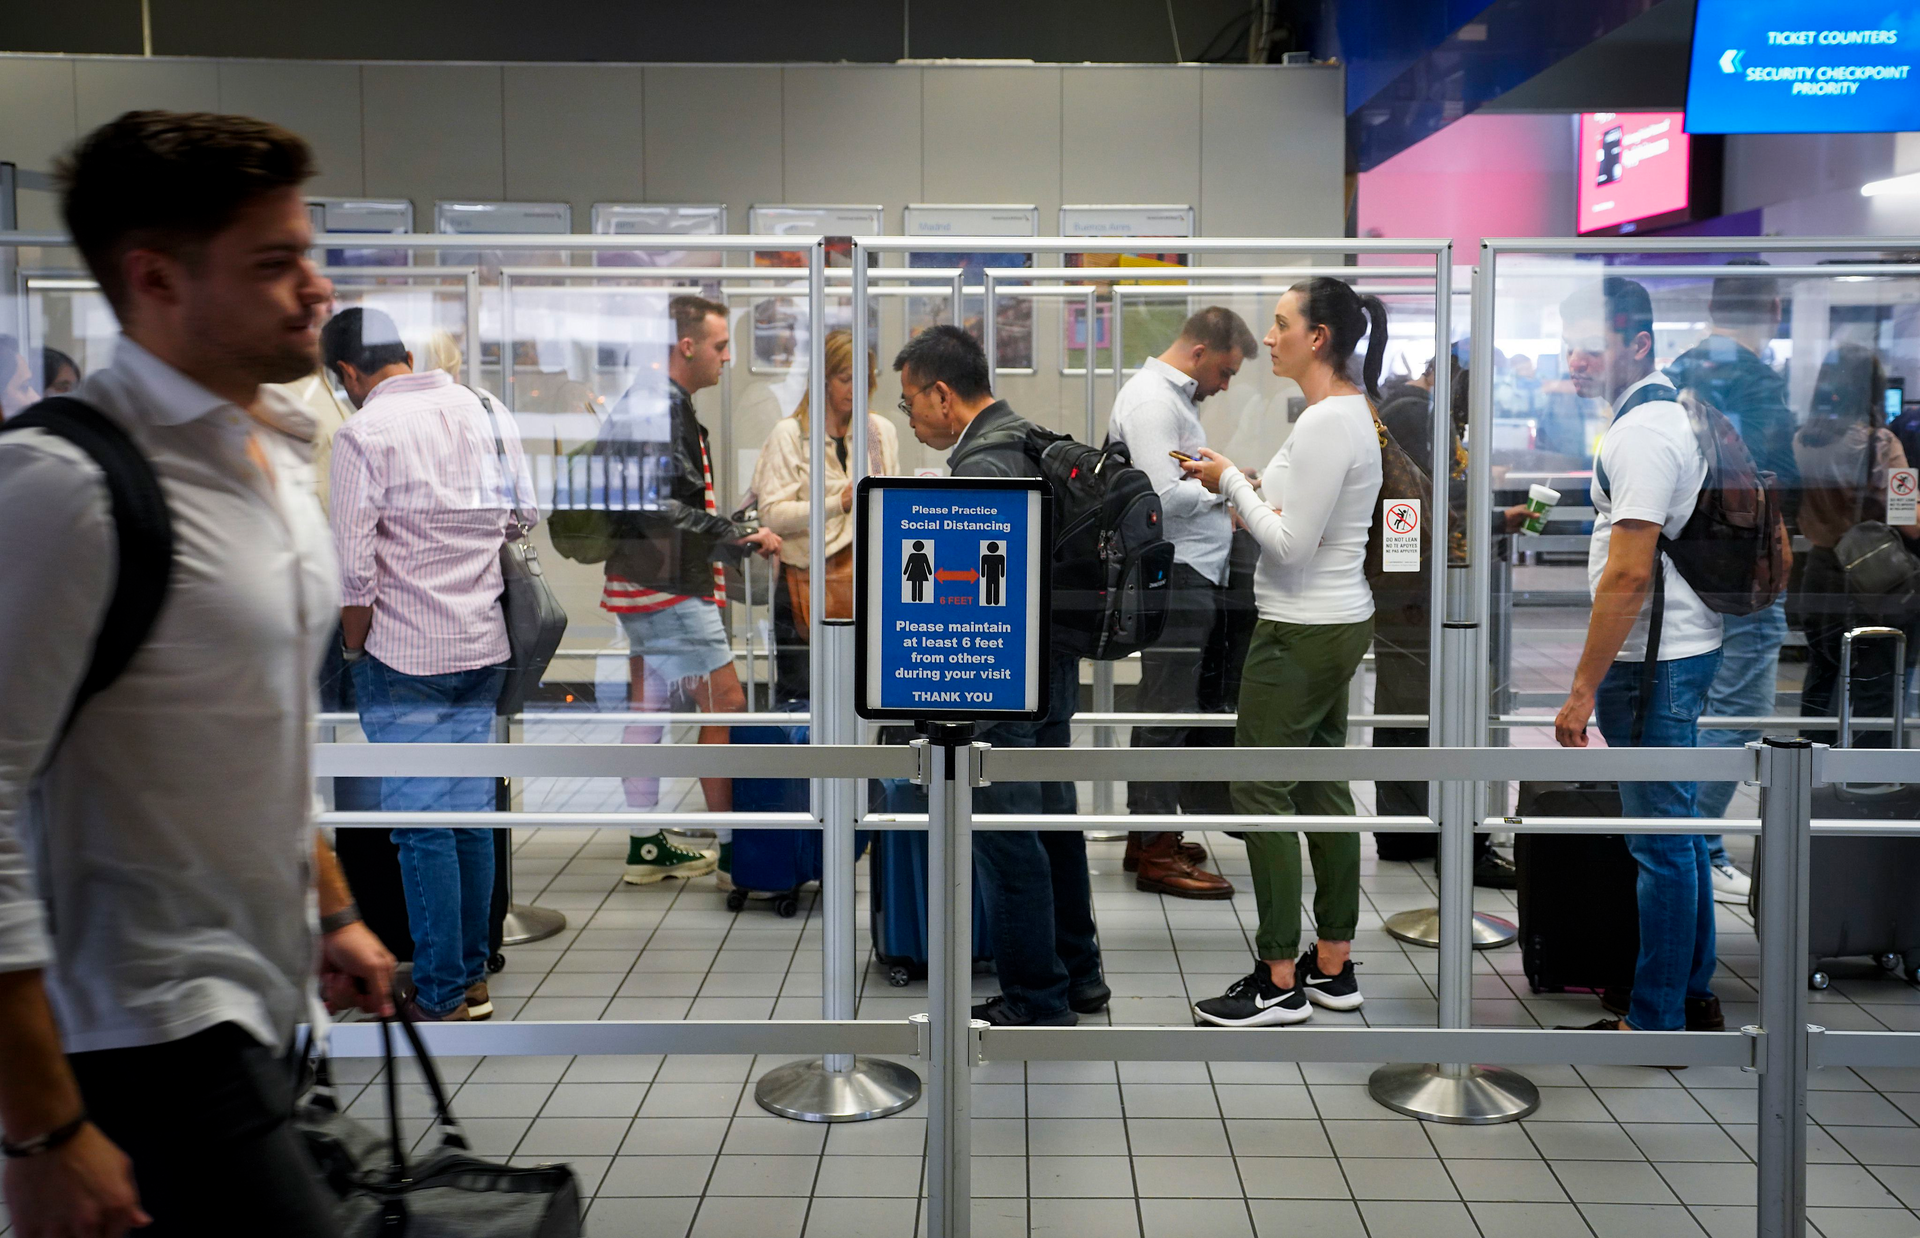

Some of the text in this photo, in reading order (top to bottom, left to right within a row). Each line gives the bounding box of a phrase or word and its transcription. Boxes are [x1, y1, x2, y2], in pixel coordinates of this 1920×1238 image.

[1767, 30, 1898, 45] TICKET COUNTERS
[1745, 65, 1911, 81] SECURITY CHECKPOINT
[1791, 81, 1860, 95] PRIORITY
[912, 505, 998, 515] Please Practice
[900, 520, 1010, 532] Social Distancing
[940, 596, 973, 605] 6 FEET
[896, 620, 1011, 632] Please maintain
[903, 637, 1004, 648] at least 6 feet
[911, 652, 995, 664] from others
[895, 668, 1010, 681] during your visit
[912, 692, 993, 702] THANK YOU
